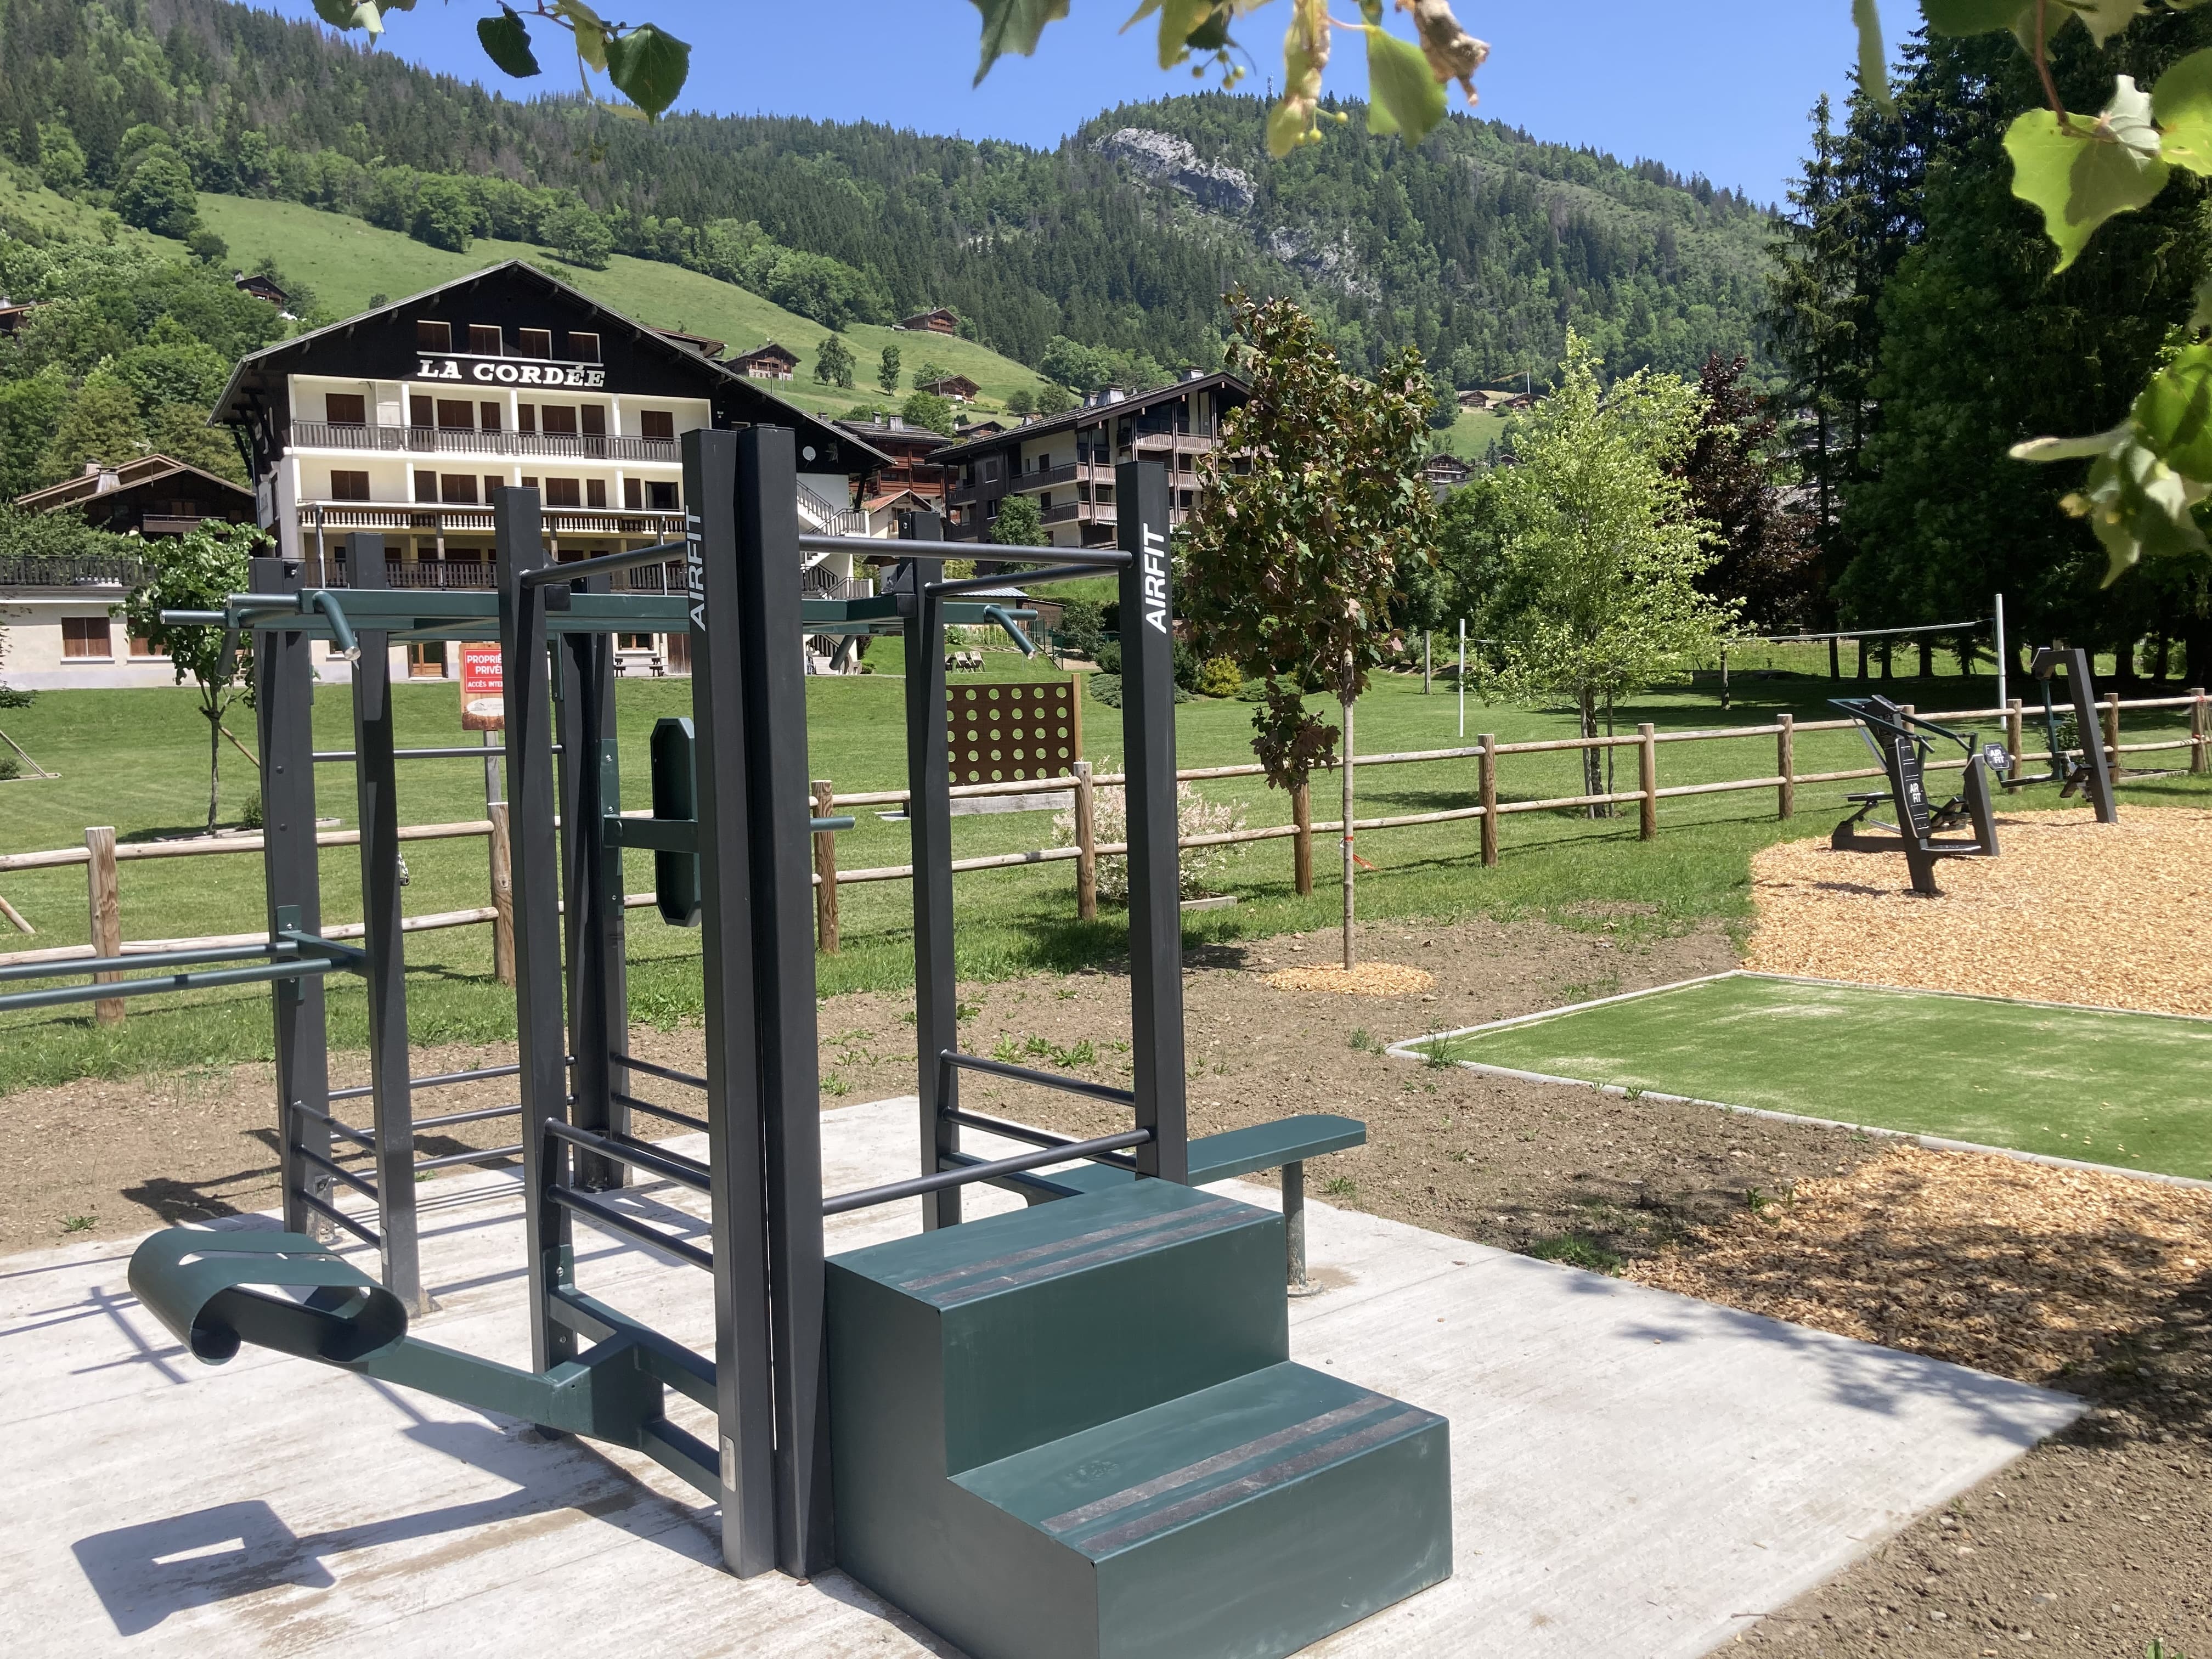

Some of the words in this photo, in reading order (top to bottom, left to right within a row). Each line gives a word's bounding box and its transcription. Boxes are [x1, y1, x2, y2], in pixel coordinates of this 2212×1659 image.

[417, 359, 462, 380] LA
[473, 363, 605, 387] CORDÉE
[686, 505, 706, 631] AIRFIT
[1143, 522, 1167, 634] AIRFIT
[467, 653, 502, 664] PROPRIÉ
[1910, 782, 1920, 793] AIR
[1912, 793, 1921, 803] FIT
